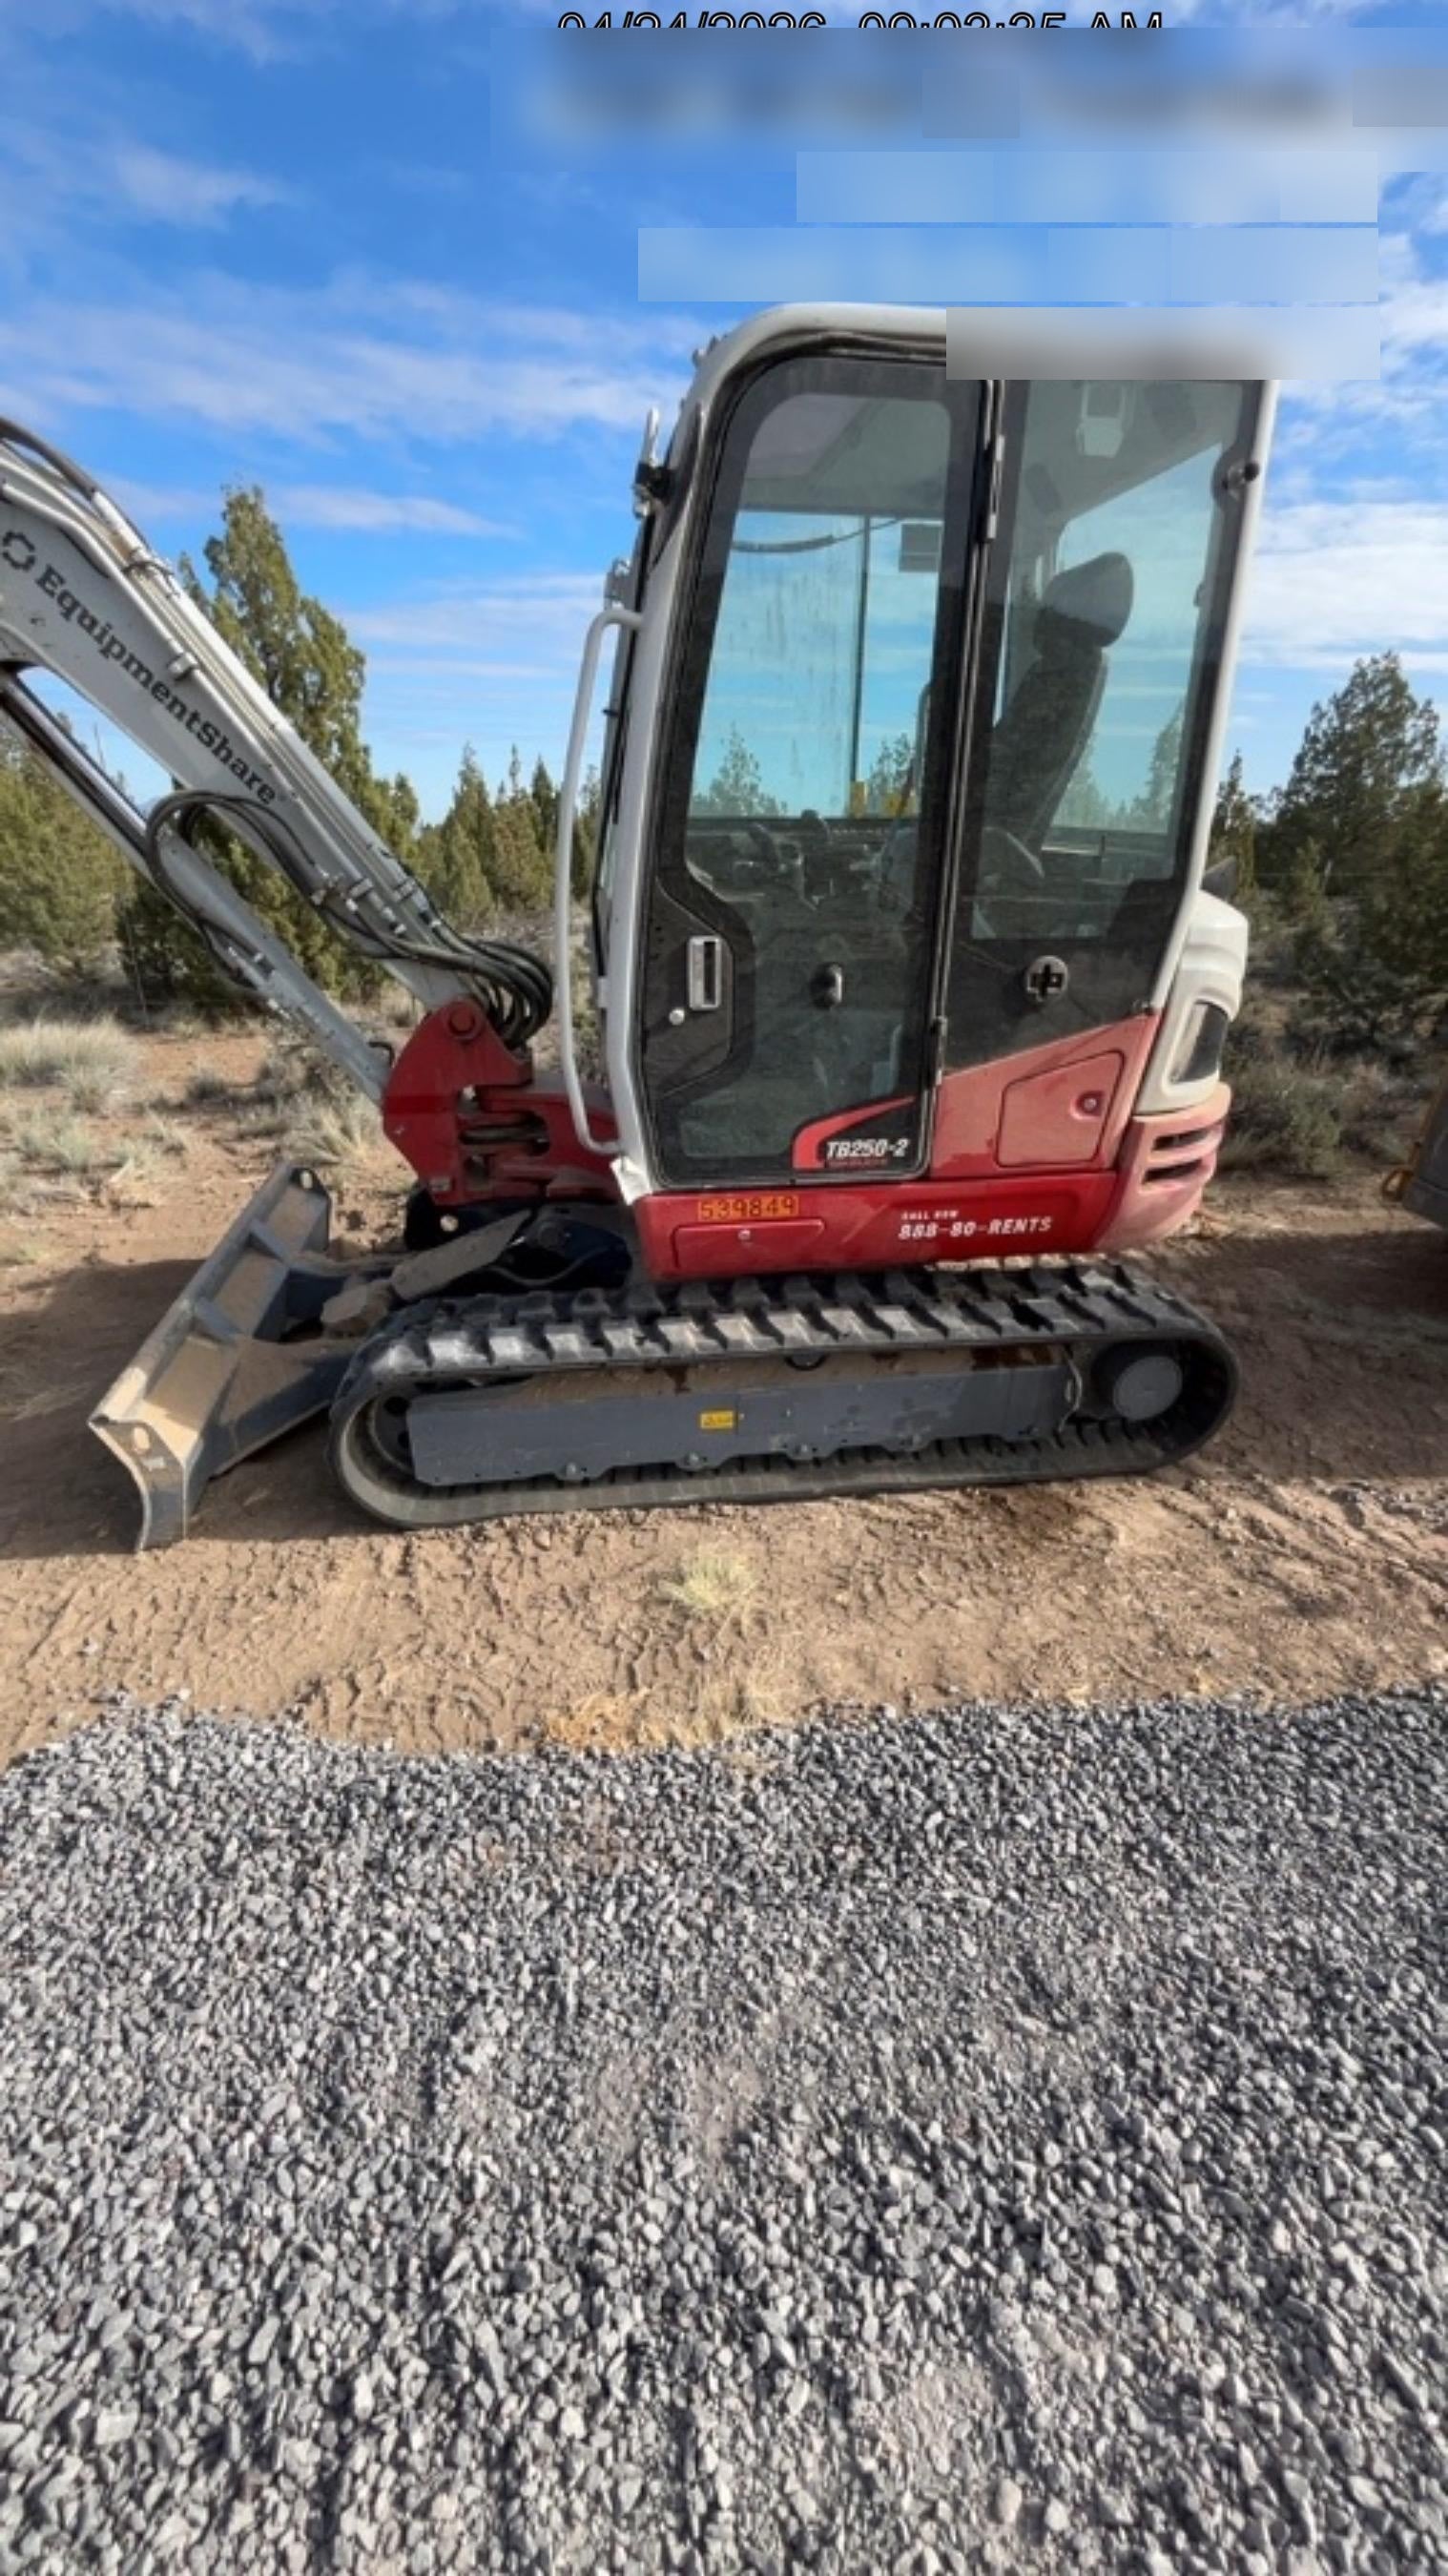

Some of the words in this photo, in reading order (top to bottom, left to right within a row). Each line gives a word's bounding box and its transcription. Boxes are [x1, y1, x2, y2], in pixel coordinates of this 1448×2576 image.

[35, 566, 277, 804] EquipmentShare
[826, 1138, 909, 1158] TB250-2
[701, 1196, 796, 1219] 539849
[899, 1215, 1052, 1239] 888-80-RENTS
